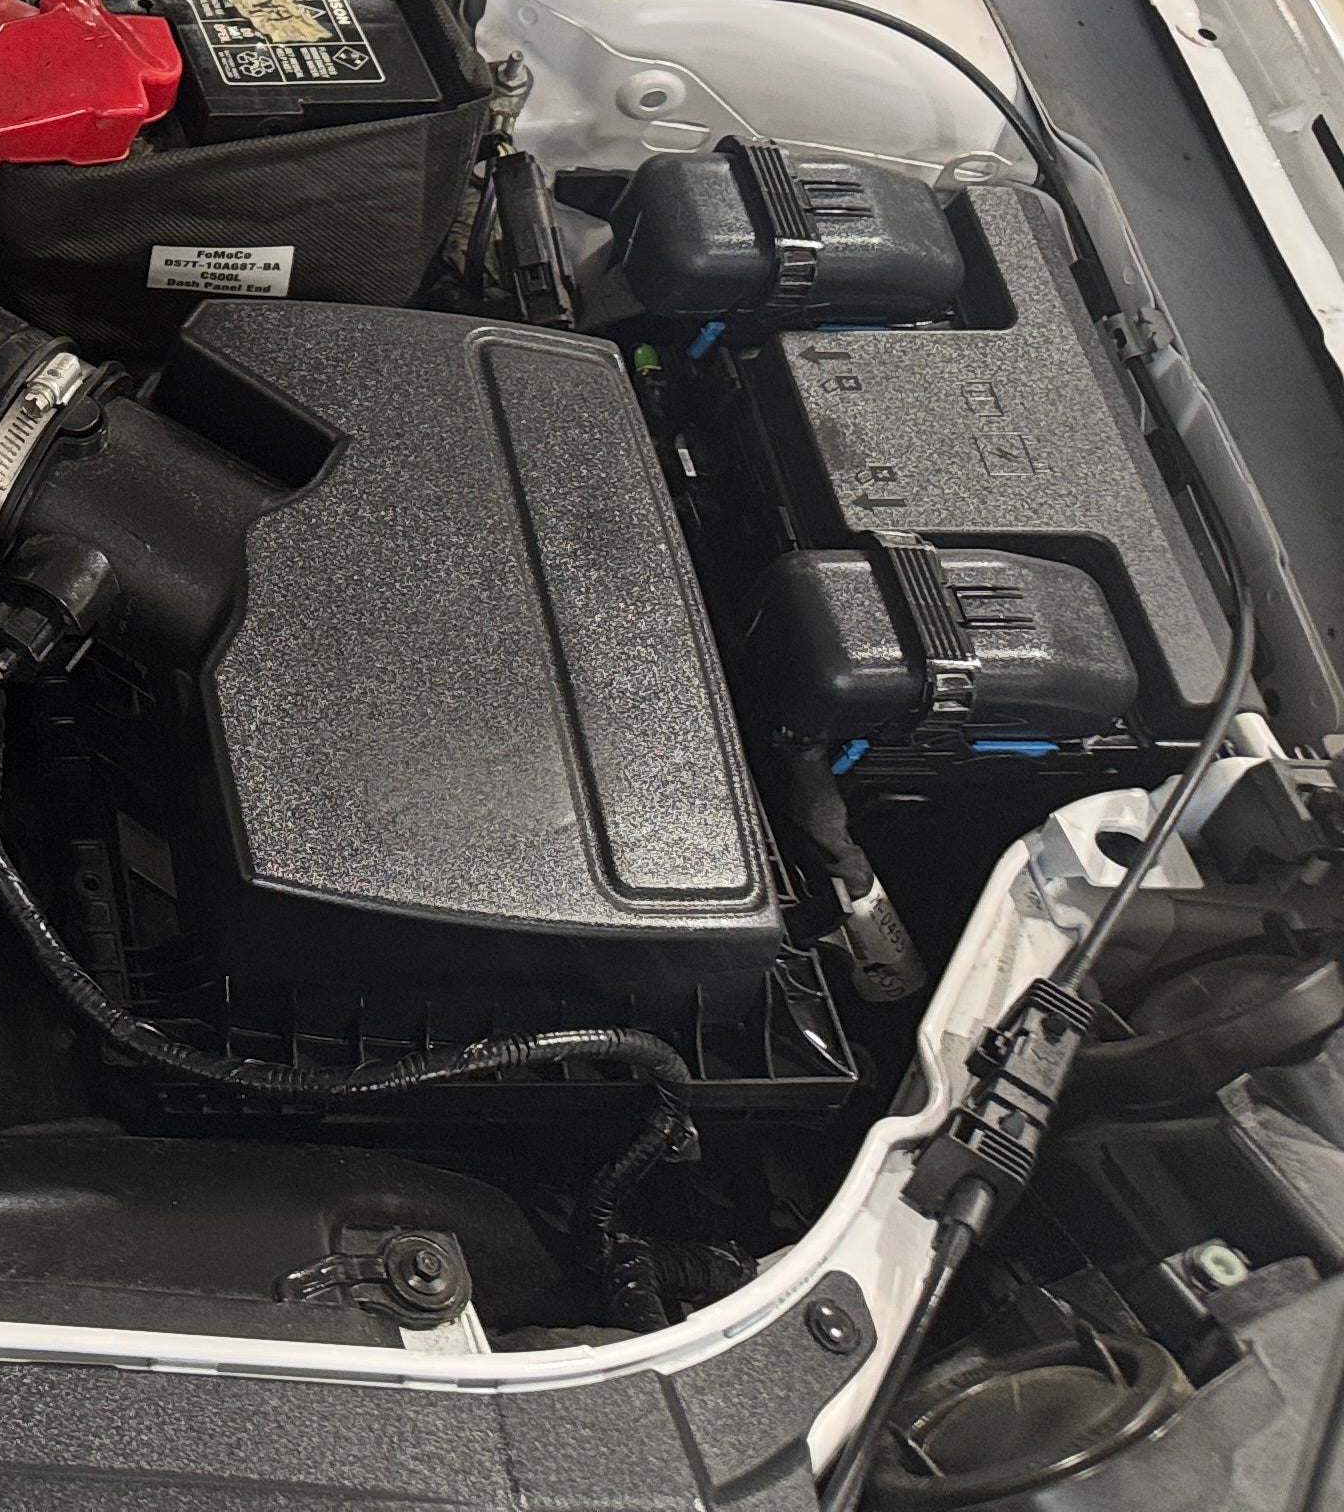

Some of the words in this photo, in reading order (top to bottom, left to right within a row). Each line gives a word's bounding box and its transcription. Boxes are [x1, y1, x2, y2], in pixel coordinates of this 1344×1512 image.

[197, 250, 252, 260] FoMoCo
[164, 259, 281, 271] DS7T-10A687-BA
[167, 278, 199, 288] Dash
[204, 282, 241, 291] Panel
[246, 284, 272, 293] End
